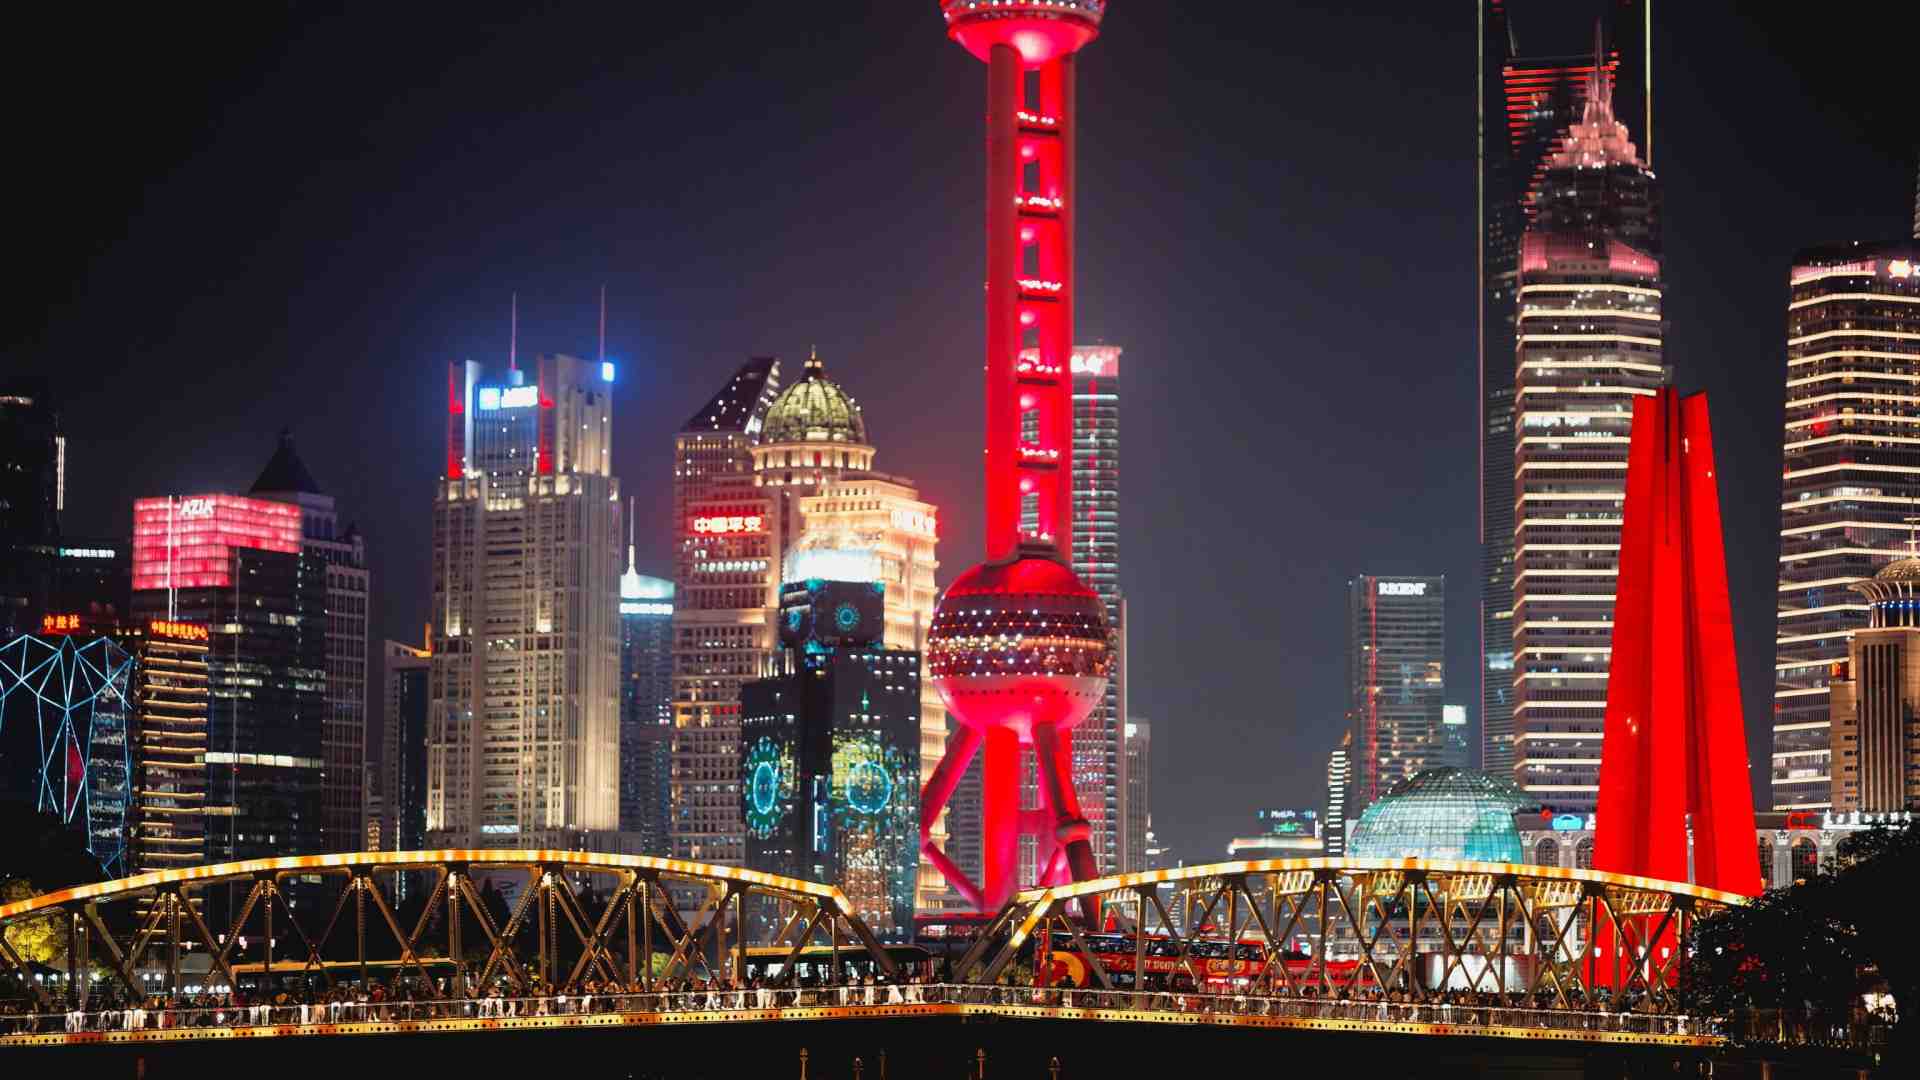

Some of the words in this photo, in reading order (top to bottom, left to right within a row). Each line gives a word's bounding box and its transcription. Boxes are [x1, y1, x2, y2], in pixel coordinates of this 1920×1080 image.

[181, 499, 214, 516] AZIA
[694, 516, 762, 533] 中国平安
